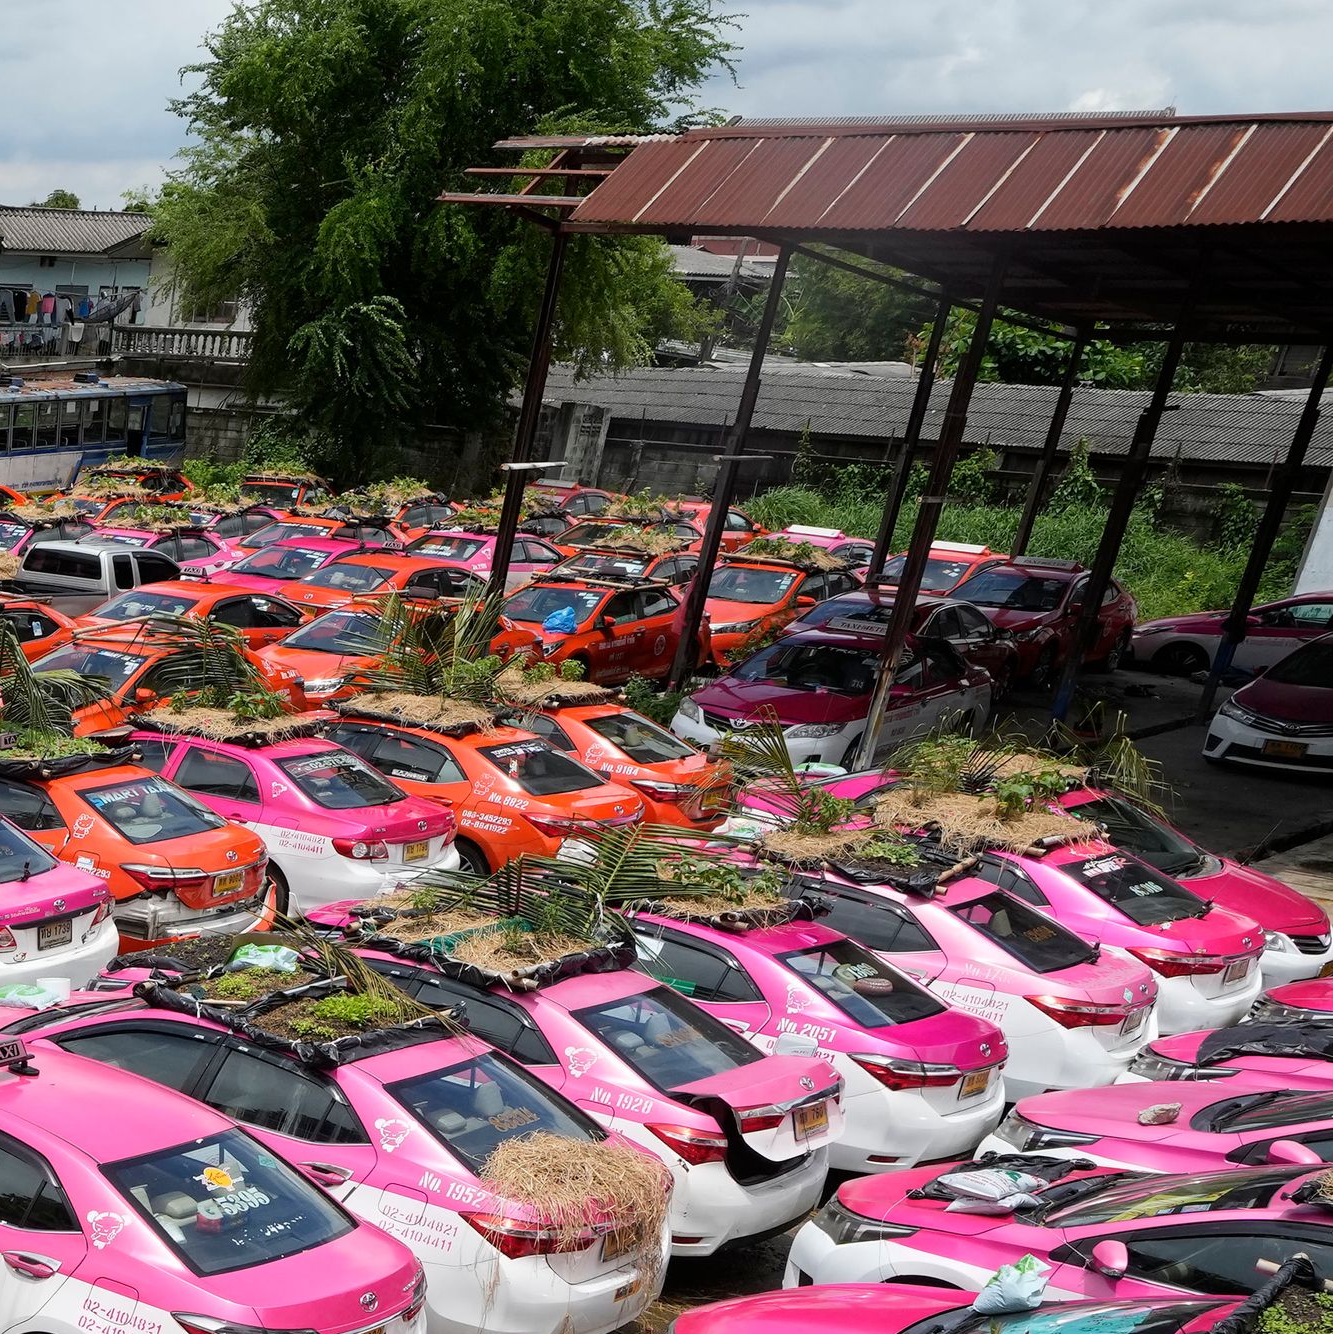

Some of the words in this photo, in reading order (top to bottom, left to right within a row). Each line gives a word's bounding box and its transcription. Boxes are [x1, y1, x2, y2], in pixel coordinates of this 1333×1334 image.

[93, 789, 138, 810] SMART
[488, 790, 501, 804] No.
[503, 793, 529, 811] 8822
[941, 988, 1009, 1012] 02-4104821
[777, 1016, 799, 1035] No.
[801, 1019, 837, 1042] 2051
[590, 1086, 612, 1105] No.
[619, 1091, 653, 1115] 1928
[197, 1188, 271, 1219] G5395
[418, 1171, 441, 1195] No.
[445, 1181, 484, 1210] 1952
[382, 1203, 458, 1237] 02-4104821
[378, 1219, 453, 1252] 02-4104411
